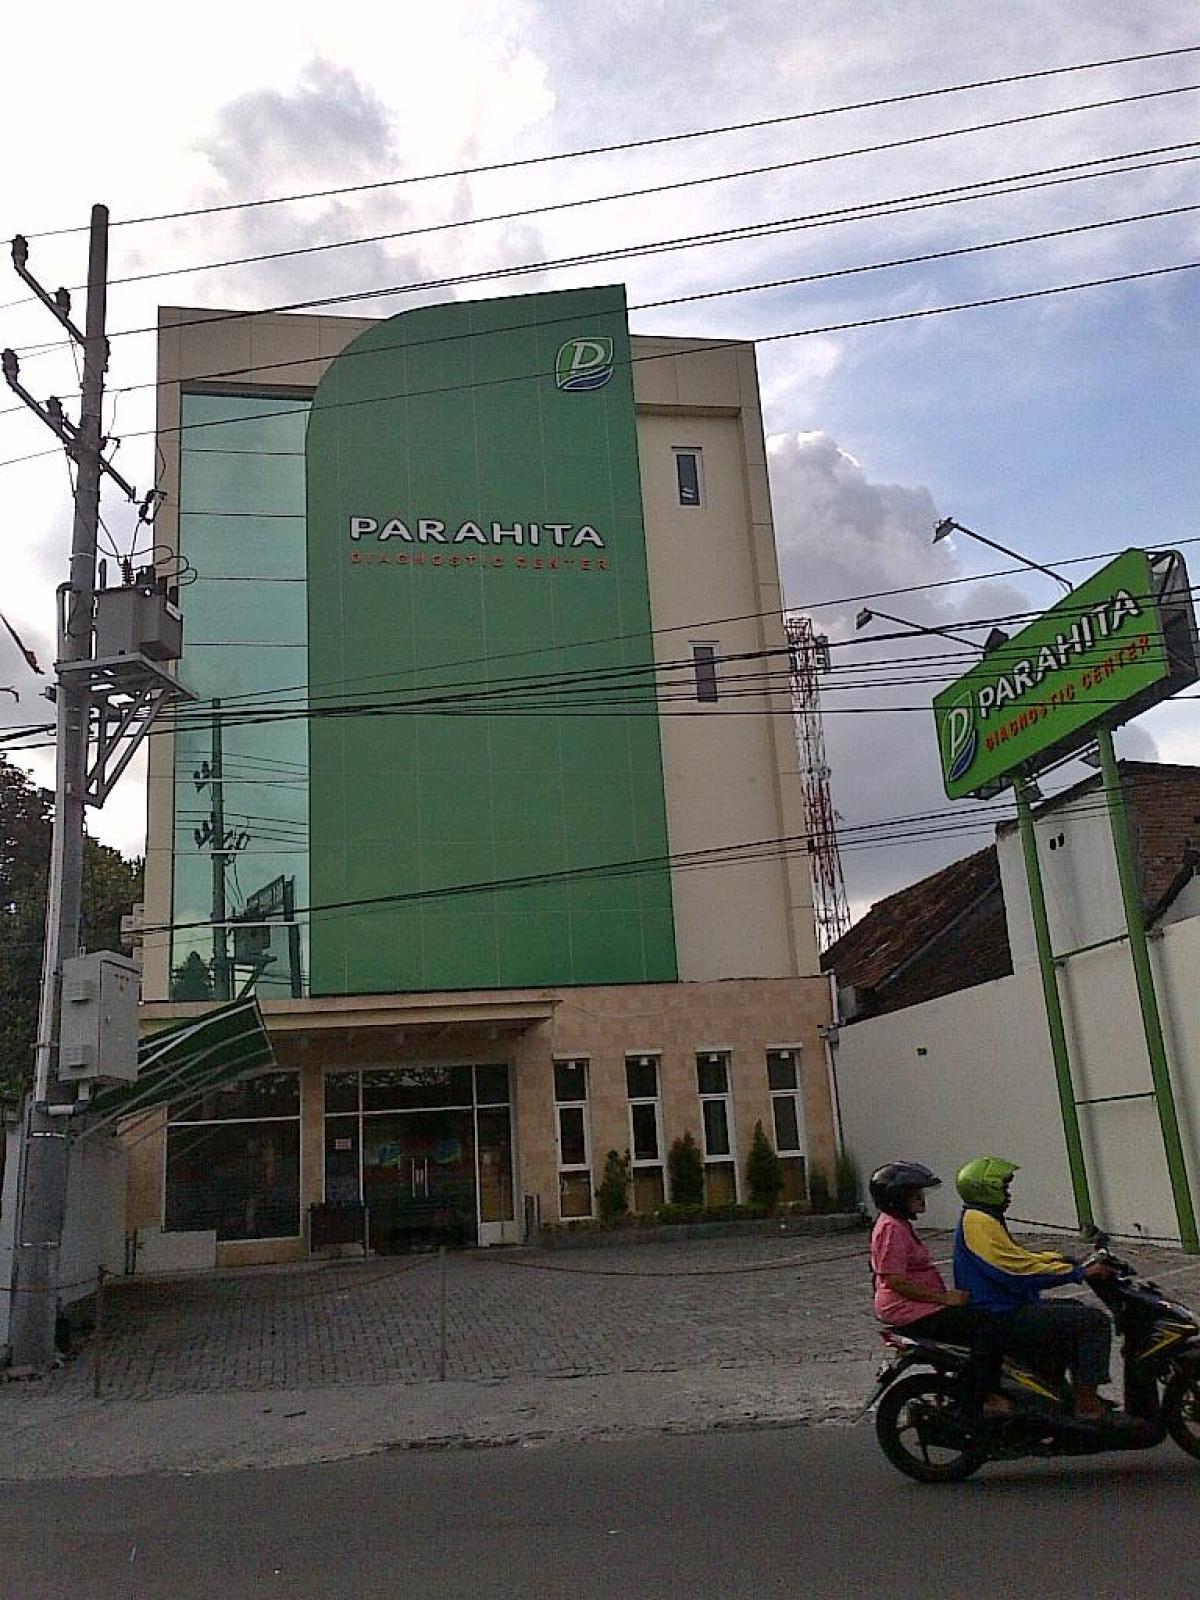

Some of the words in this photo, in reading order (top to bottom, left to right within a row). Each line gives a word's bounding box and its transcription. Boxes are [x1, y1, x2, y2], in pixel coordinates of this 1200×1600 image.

[350, 516, 605, 547] PARAHITA
[514, 555, 609, 571] CENTER
[979, 590, 1139, 717] PARAHITA
